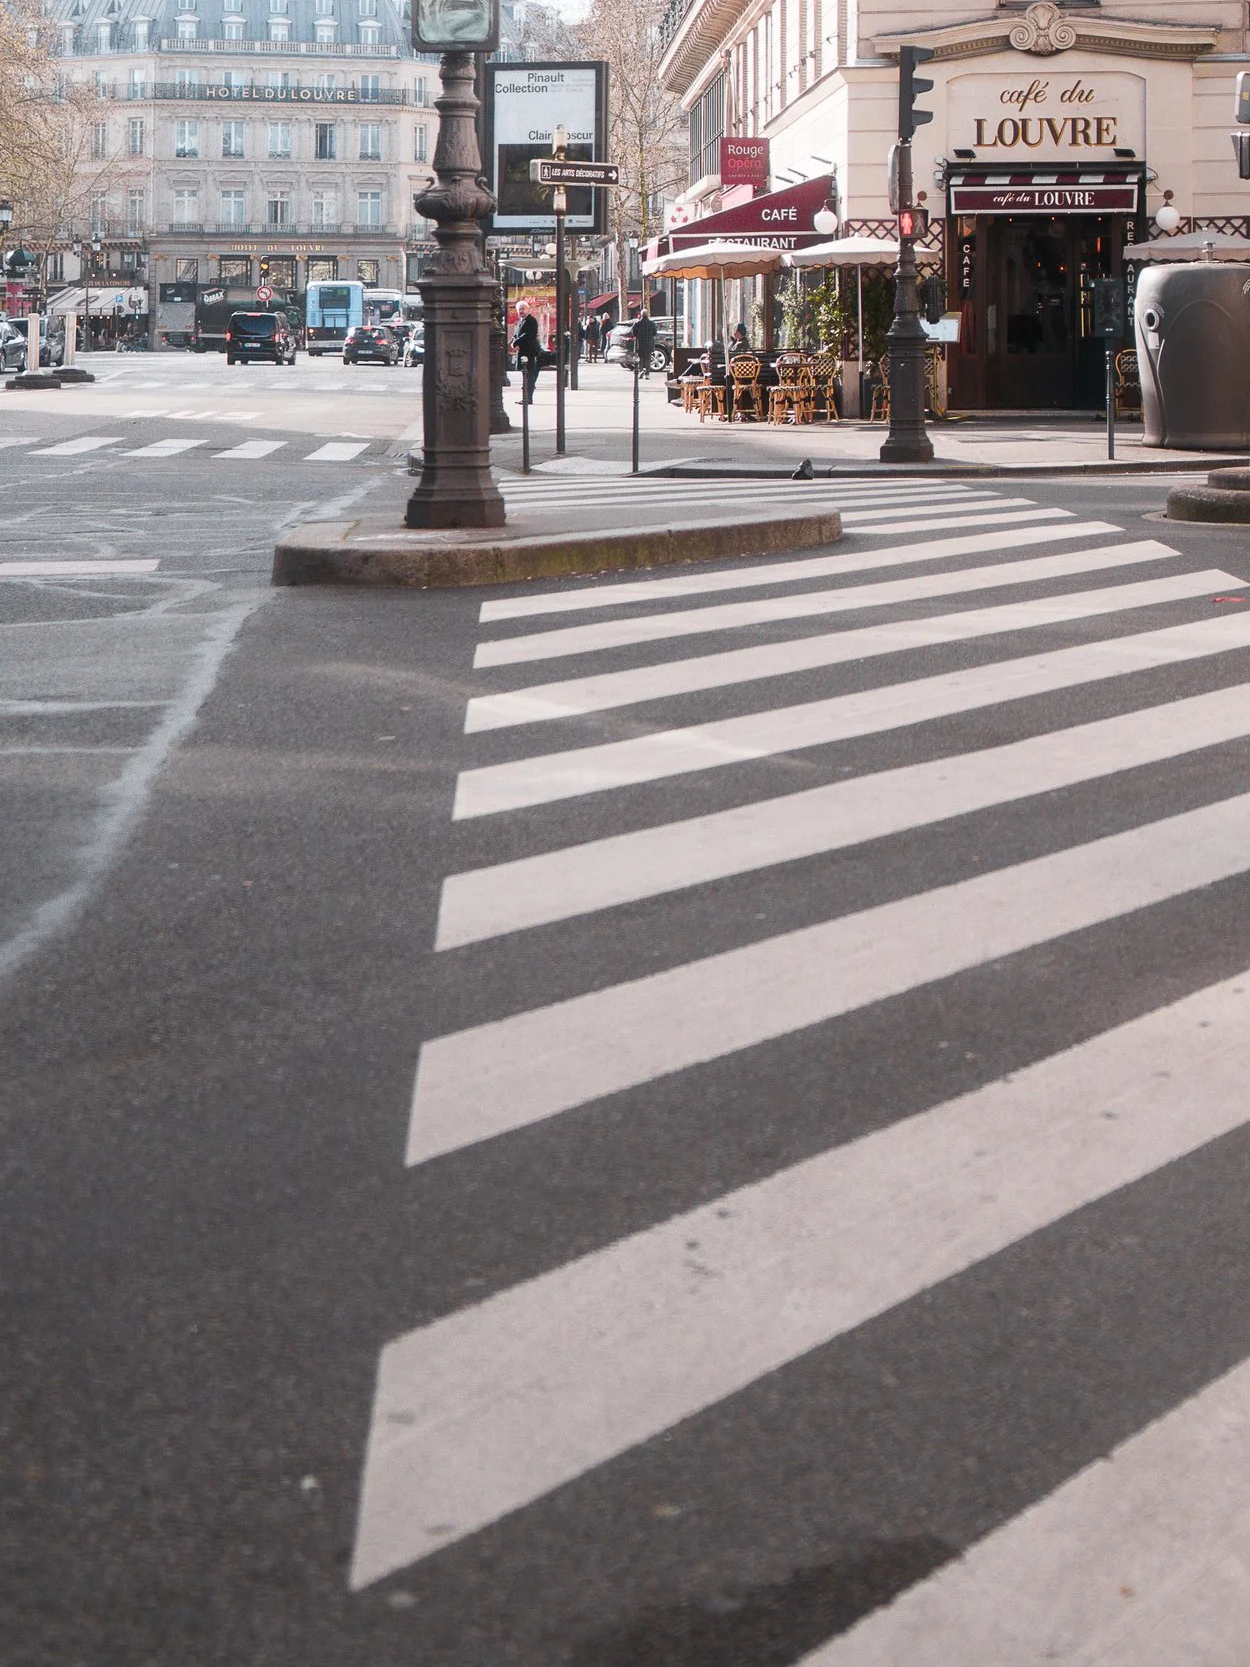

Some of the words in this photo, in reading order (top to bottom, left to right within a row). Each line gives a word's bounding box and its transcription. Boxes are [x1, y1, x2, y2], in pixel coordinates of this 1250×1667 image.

[527, 72, 565, 83] Pinault
[265, 89, 287, 99] DU
[291, 89, 356, 101] LOUVRE
[495, 83, 548, 94] Collection
[1000, 79, 1049, 112] café
[1060, 79, 1094, 104] du
[973, 116, 1118, 148] LOUVRE
[727, 144, 764, 159] Rouge
[727, 156, 764, 171] Opéra
[551, 168, 562, 176] LES
[561, 169, 575, 177] ARTS
[576, 168, 605, 179] DÉCORATIFS
[993, 192, 1015, 206] café
[1016, 192, 1031, 202] du
[1034, 191, 1095, 206] LOUVRE
[761, 206, 798, 221] CAFÉ
